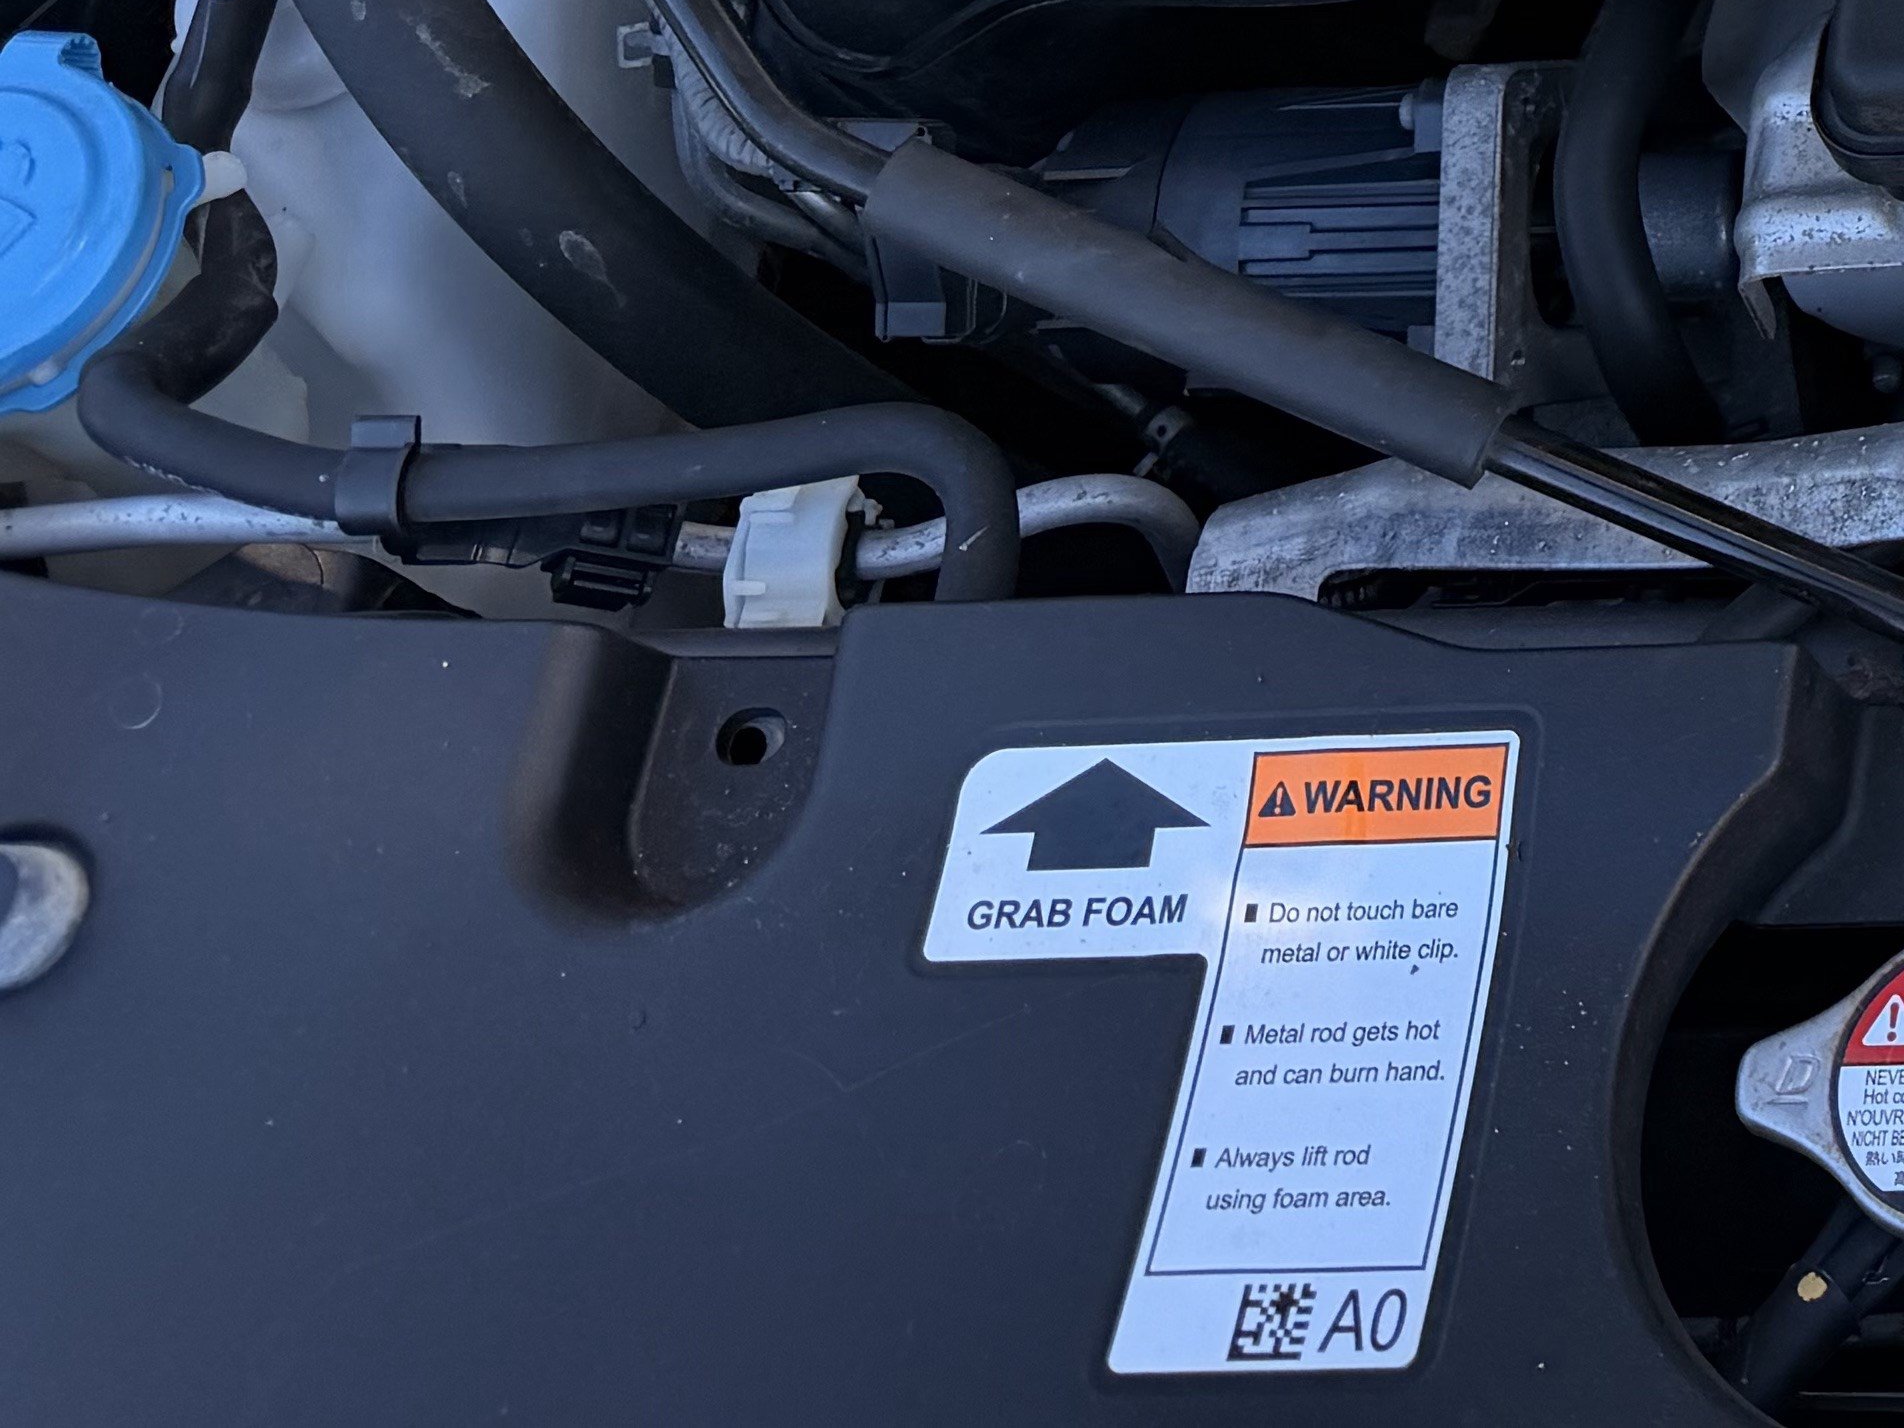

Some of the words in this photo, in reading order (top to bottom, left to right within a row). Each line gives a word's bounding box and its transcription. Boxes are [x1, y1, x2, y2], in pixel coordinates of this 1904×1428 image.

[1303, 774, 1494, 814] WARNING
[966, 897, 1072, 931] GRAB
[1082, 893, 1190, 928] FOAM
[1268, 902, 1301, 924] Do
[1307, 901, 1343, 923] not
[1346, 899, 1405, 922] touch
[1410, 897, 1460, 919] bare
[1260, 941, 1320, 964] metal
[1326, 945, 1351, 963] or
[1355, 939, 1411, 962] white
[1417, 938, 1459, 965] clip.
[1244, 1023, 1306, 1045] Metal
[1310, 1021, 1348, 1043] rod
[1352, 1023, 1399, 1047] gets
[1405, 1019, 1441, 1041] hot
[1234, 1064, 1279, 1086] and
[1283, 1066, 1323, 1085] can
[1328, 1062, 1380, 1084] burn
[1385, 1060, 1447, 1082] hand.
[1863, 1088, 1889, 1105] Hot
[1851, 1129, 1889, 1147] NICHT
[1214, 1146, 1296, 1173] Always
[1300, 1145, 1329, 1167] lift
[1333, 1144, 1373, 1167] rod
[1205, 1189, 1268, 1214] using
[1272, 1187, 1329, 1209] foam
[1335, 1189, 1392, 1208] area.
[1316, 1286, 1409, 1355] A0
